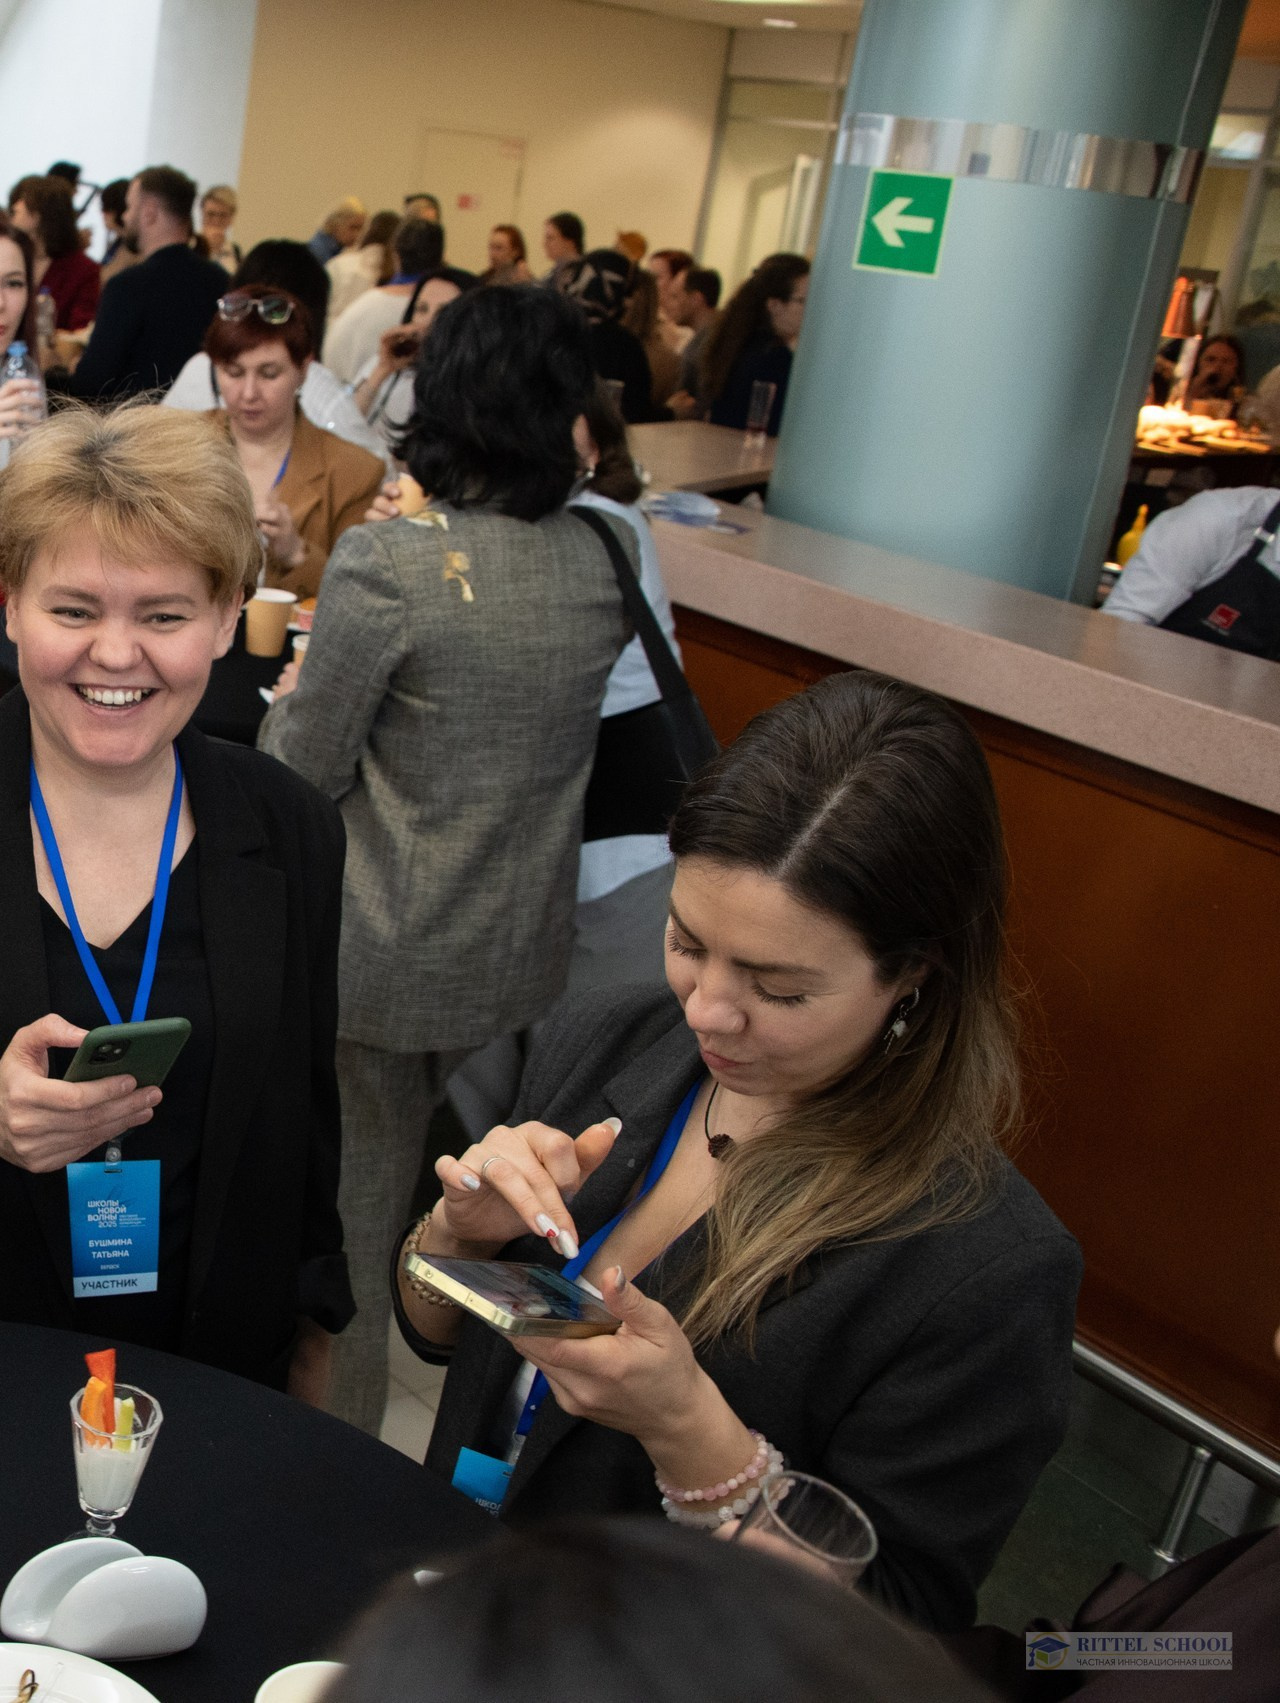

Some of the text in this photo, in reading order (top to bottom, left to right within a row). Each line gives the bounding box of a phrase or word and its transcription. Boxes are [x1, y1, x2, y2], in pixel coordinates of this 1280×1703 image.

[87, 1200, 119, 1208] ШКОЛЫ
[97, 1204, 127, 1214] НОВОЙ
[87, 1213, 118, 1222] ВОЛНЫ
[98, 1220, 118, 1228] 2025
[88, 1238, 133, 1248] БУШМИНА
[91, 1250, 130, 1259] ТАТЬЯНА
[81, 1278, 138, 1290] УЧАСТНИК
[475, 1497, 502, 1511] ШКОЛ
